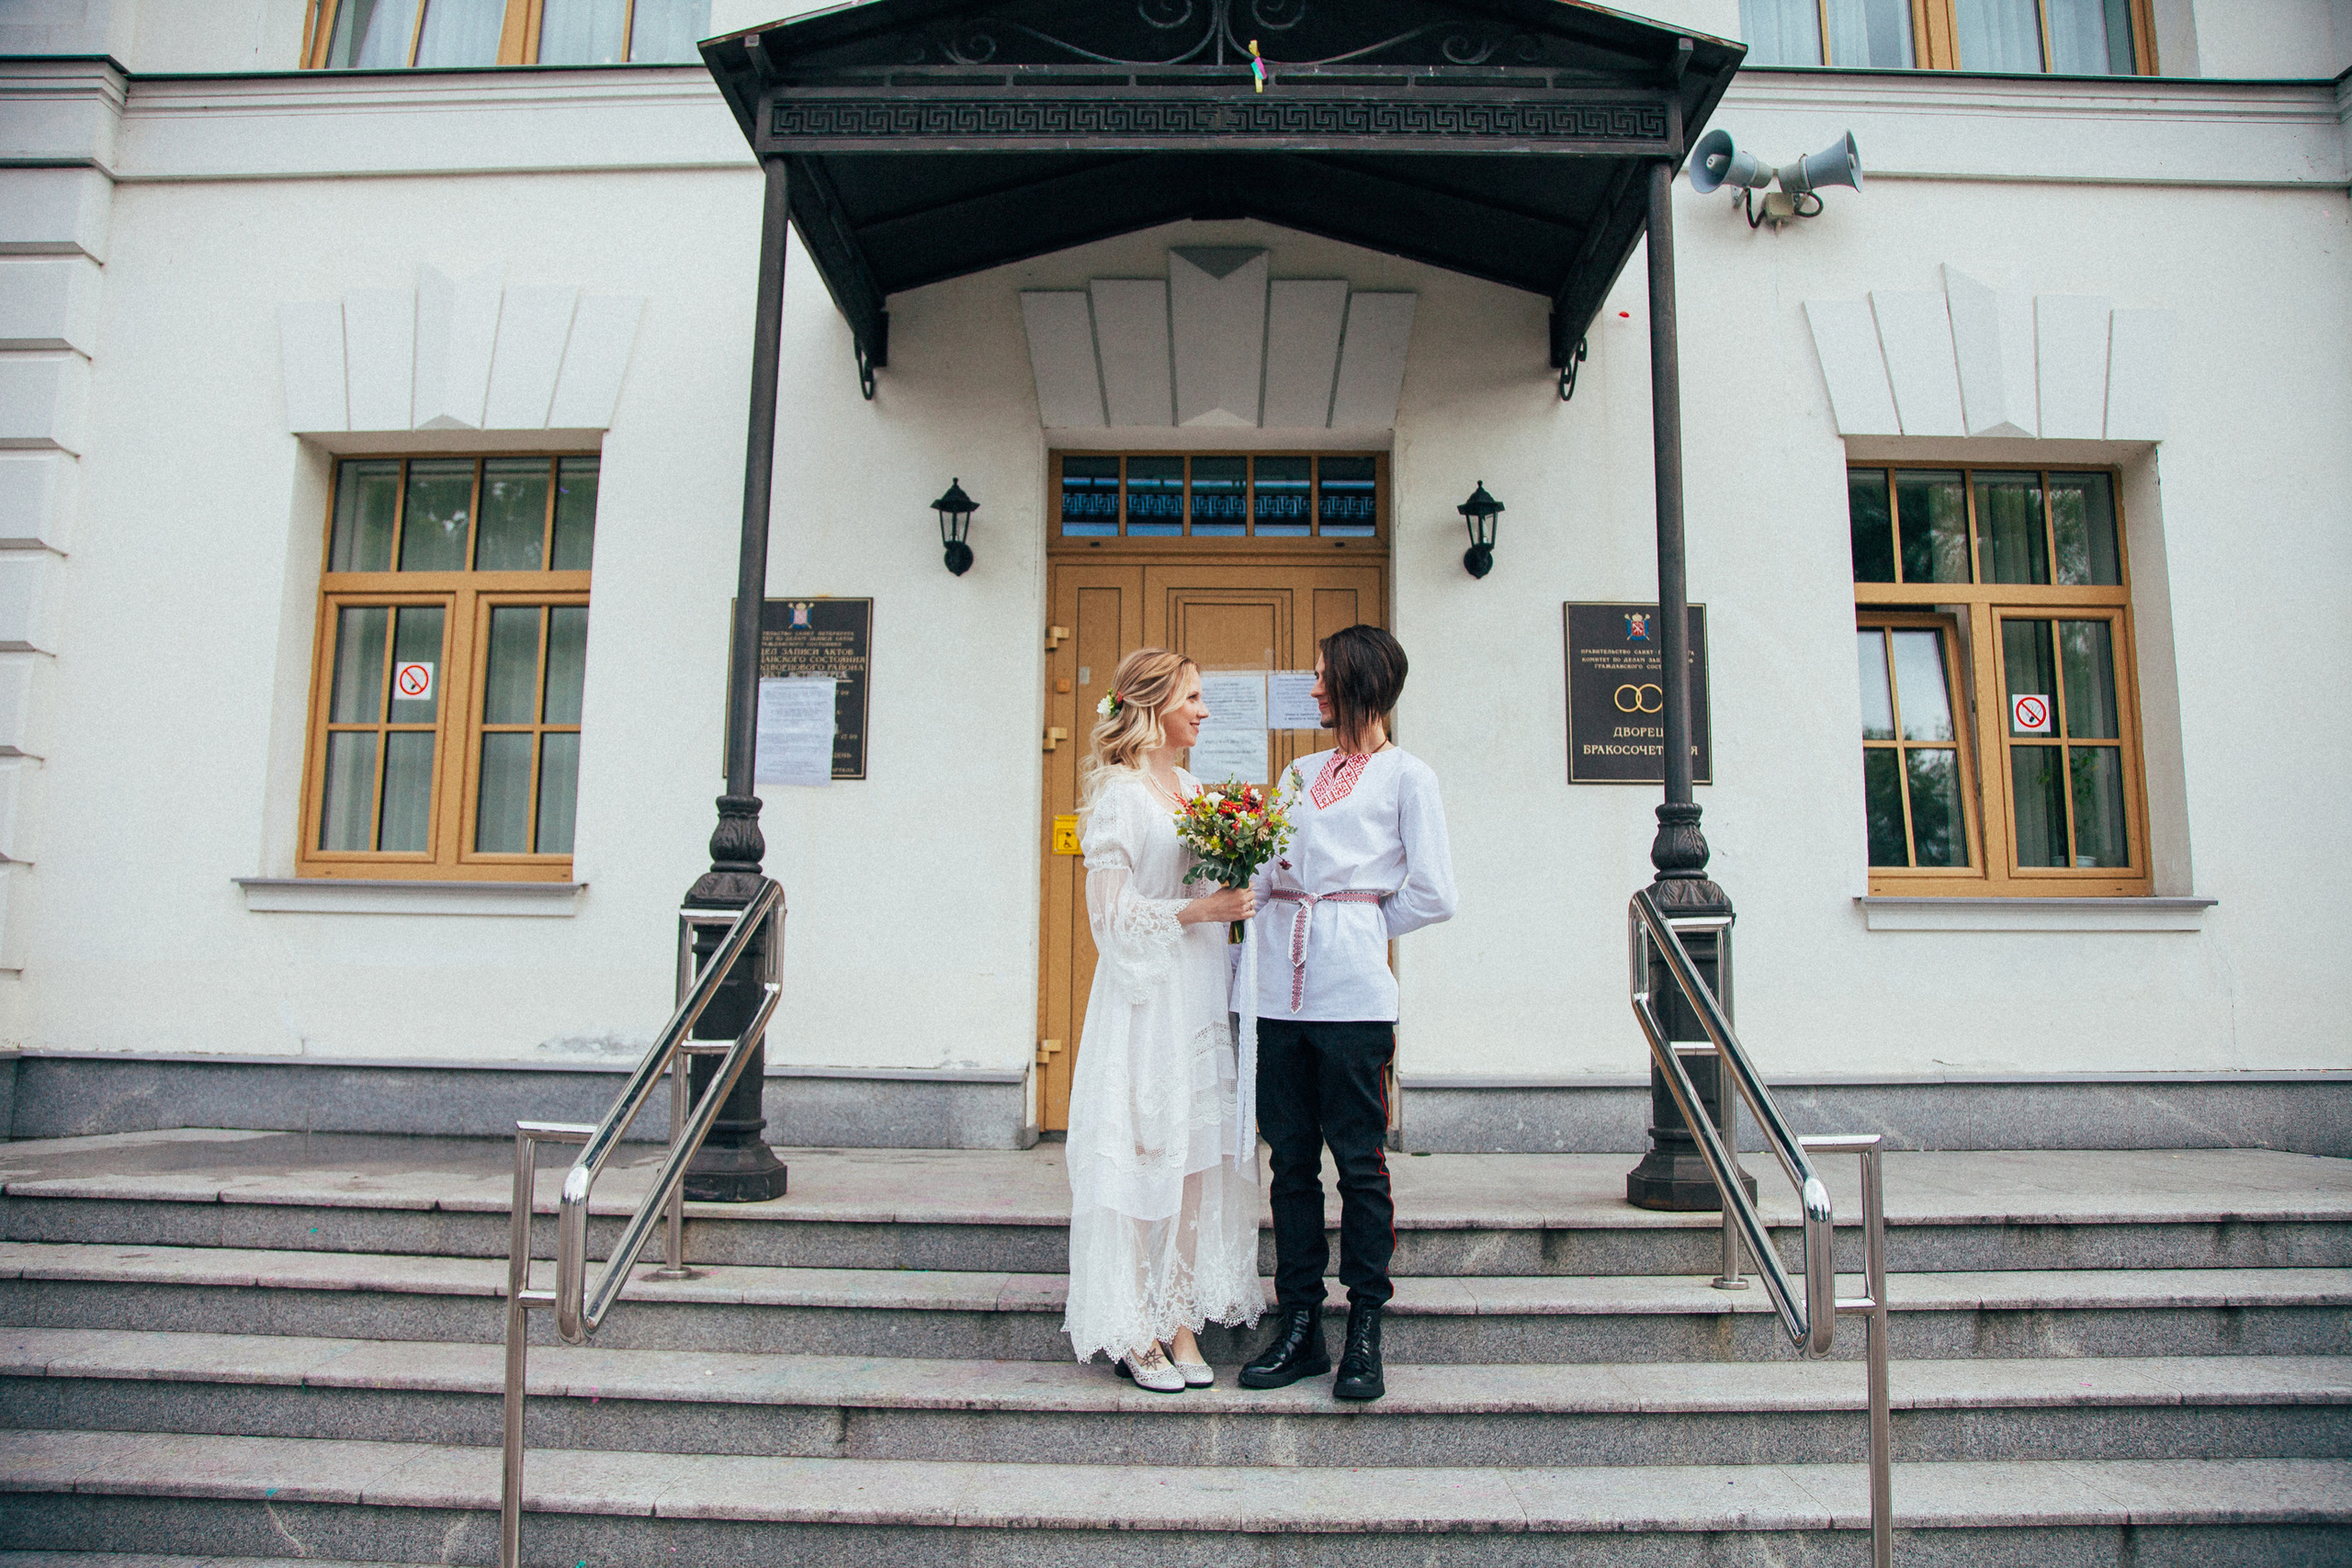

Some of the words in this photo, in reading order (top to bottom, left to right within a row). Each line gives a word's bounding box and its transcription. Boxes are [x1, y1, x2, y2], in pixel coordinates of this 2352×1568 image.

[808, 655, 865, 663] СОСТОЯНИЯ
[827, 662, 865, 671] РАЙОНА
[1613, 727, 1664, 739] ДВОРЕЦ
[1583, 744, 1699, 756] БРАКОСОЧЕТЯ
